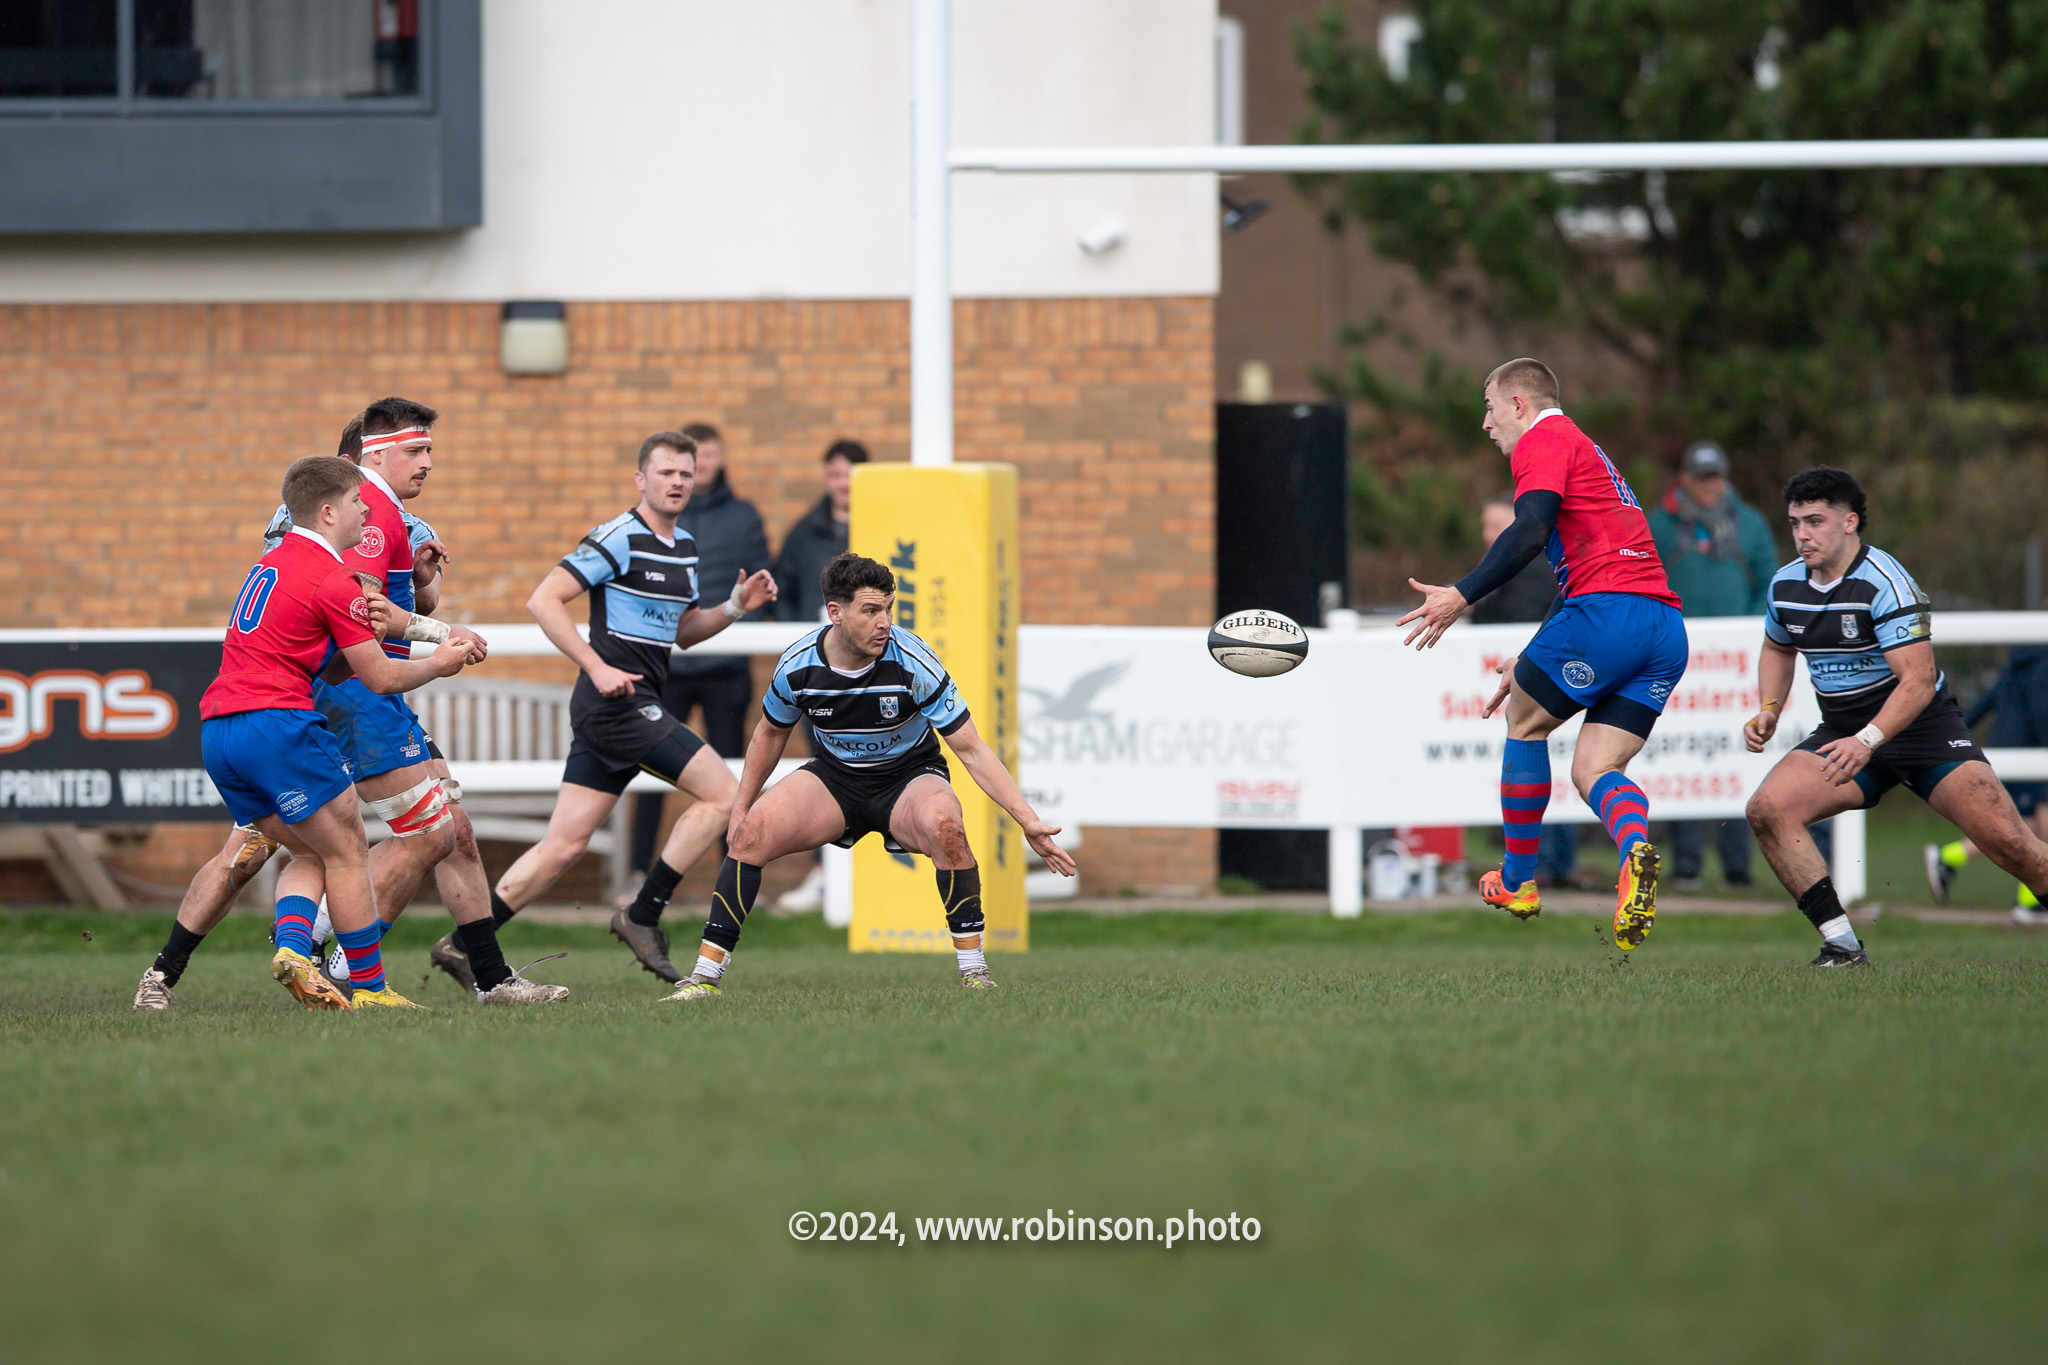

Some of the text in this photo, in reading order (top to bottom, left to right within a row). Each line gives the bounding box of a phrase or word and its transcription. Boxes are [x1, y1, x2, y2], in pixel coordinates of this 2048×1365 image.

[227, 564, 279, 635] 10
[889, 538, 916, 630] ark
[1222, 616, 1300, 637] GILBERT
[0, 769, 112, 808] PRINTED
